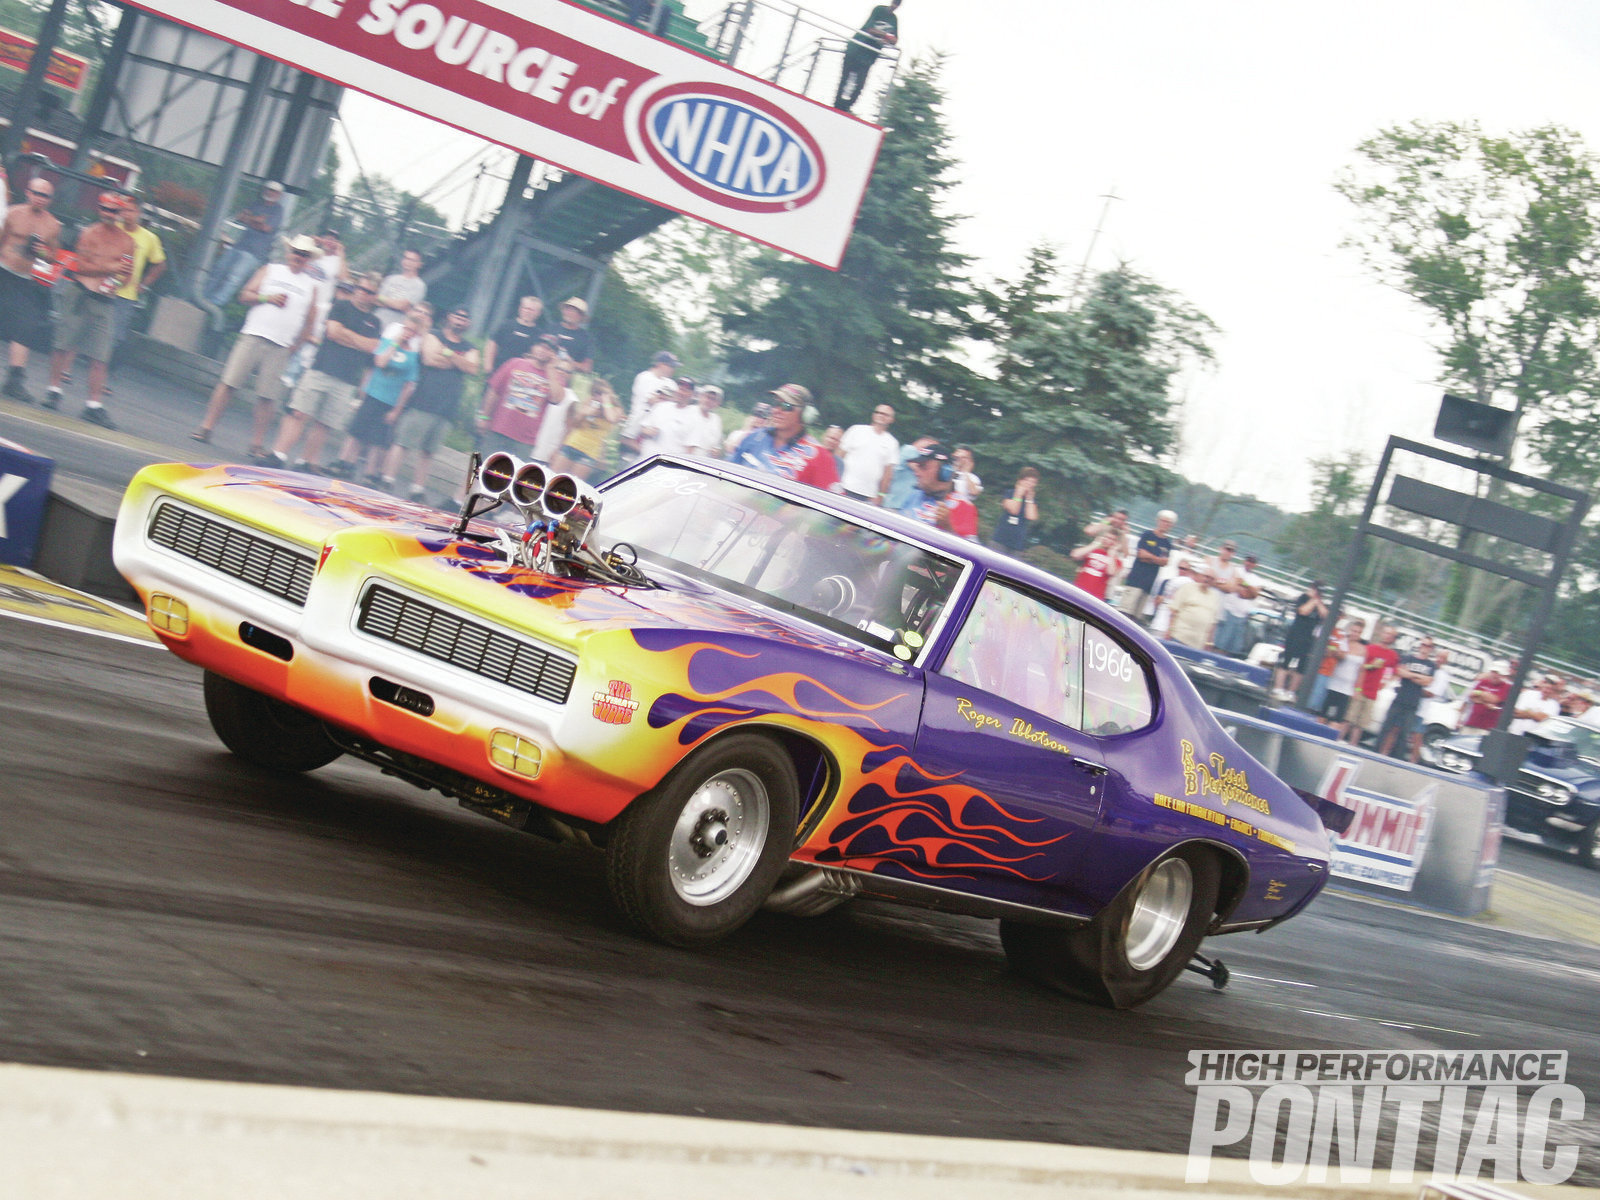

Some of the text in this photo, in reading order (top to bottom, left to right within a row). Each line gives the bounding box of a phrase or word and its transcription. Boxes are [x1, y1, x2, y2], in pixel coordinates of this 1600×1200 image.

[356, 0, 628, 121] SOURCE of
[661, 101, 801, 194] NHRA
[1088, 639, 1132, 683] 196G
[608, 680, 632, 700] THE
[956, 697, 1070, 754] Roger Ibbotson
[1196, 763, 1271, 815] Performance
